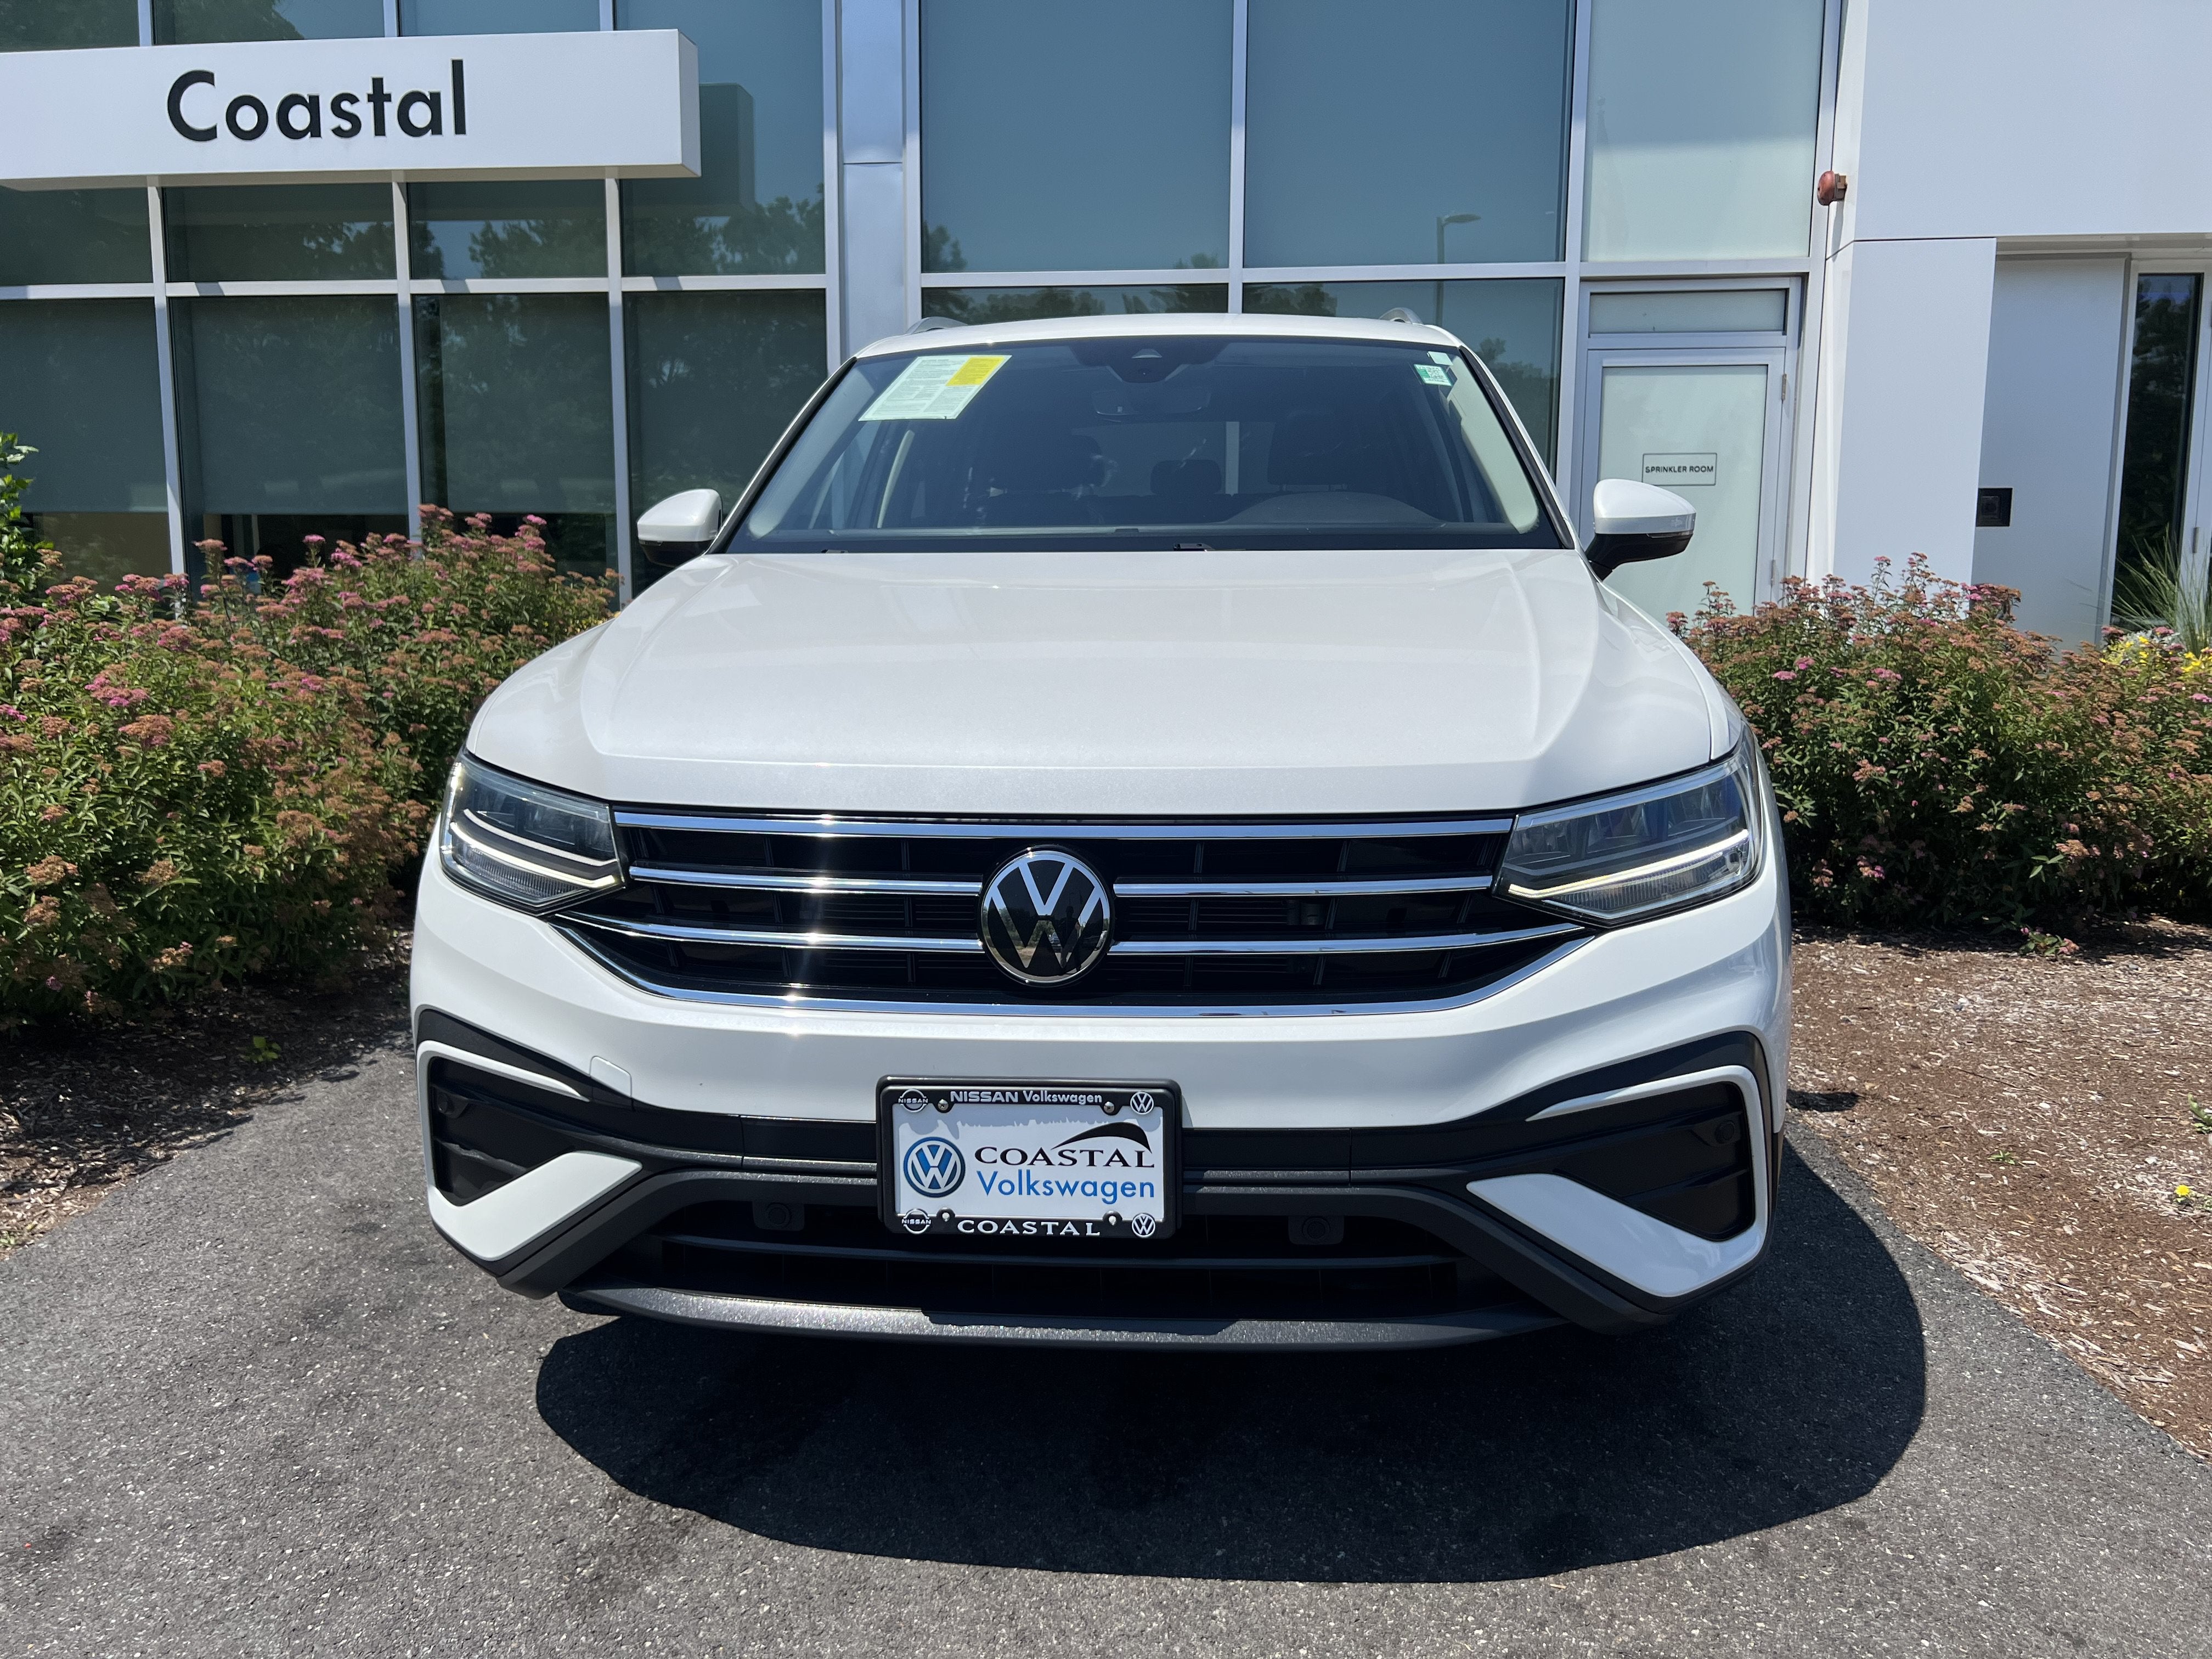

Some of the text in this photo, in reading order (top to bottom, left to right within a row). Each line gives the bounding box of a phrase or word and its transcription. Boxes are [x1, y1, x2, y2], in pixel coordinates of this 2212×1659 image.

[166, 59, 466, 143] Coastal
[950, 1090, 1102, 1105] NISSAN Volkswagen
[974, 1147, 1154, 1168] COASTAL
[977, 1169, 1154, 1204] Volkswagen
[957, 1220, 1100, 1236] COASTAL
